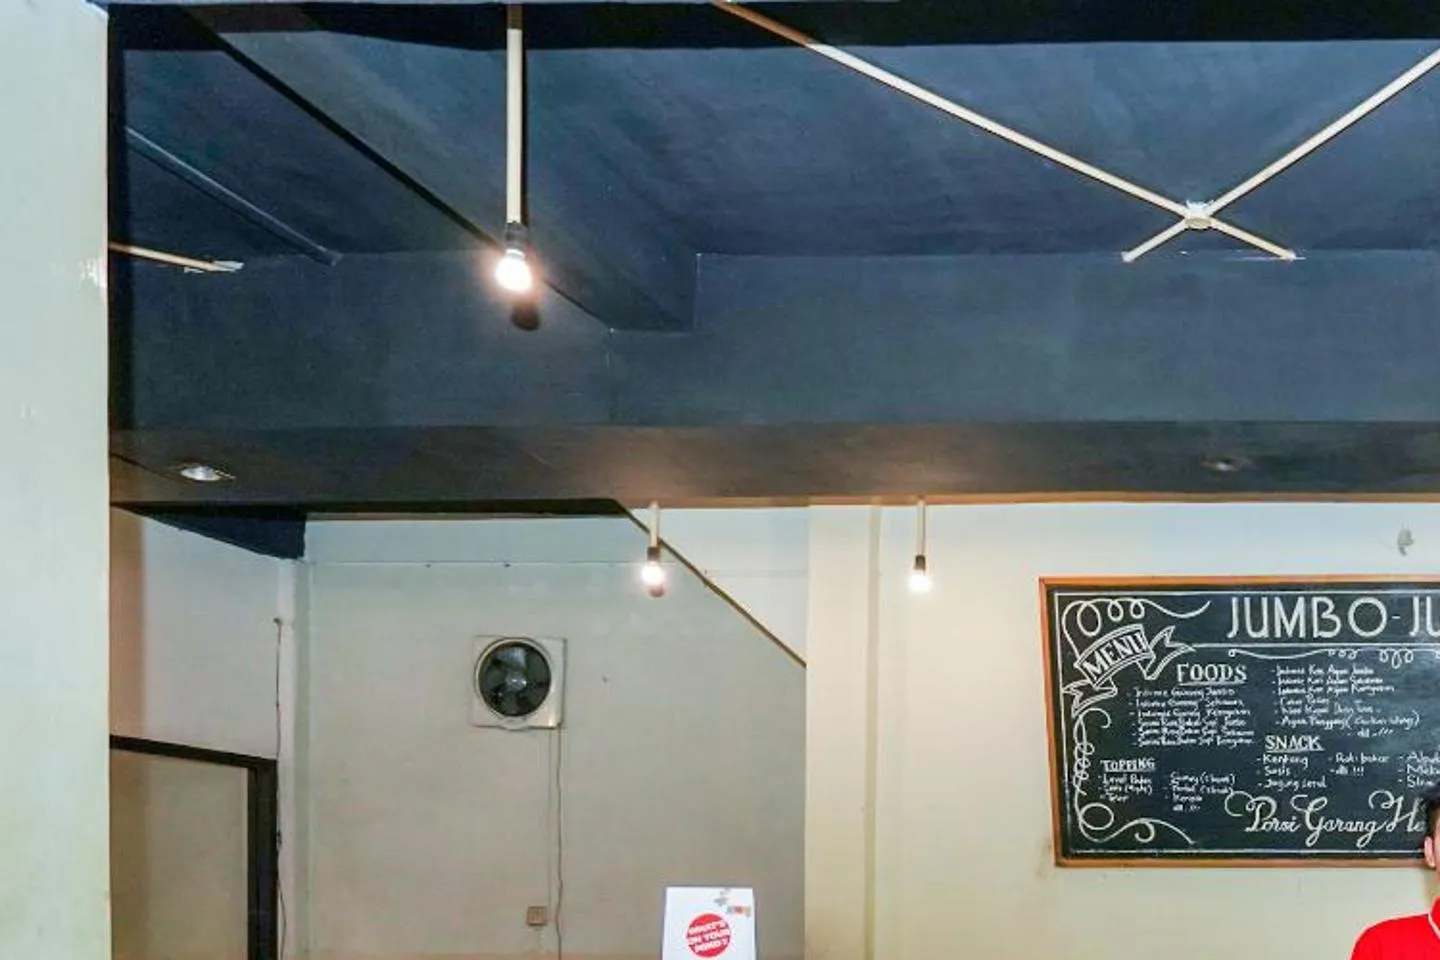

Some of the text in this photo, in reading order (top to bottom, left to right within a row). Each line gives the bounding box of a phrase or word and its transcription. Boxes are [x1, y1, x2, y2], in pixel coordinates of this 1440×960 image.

[1226, 595, 1388, 639] JUMBO
[1081, 631, 1148, 682] MENU
[1176, 661, 1248, 682] FOODS
[1264, 734, 1324, 751] SNACK
[1100, 758, 1156, 772] TOPPING
[1240, 795, 1301, 834] Porsi
